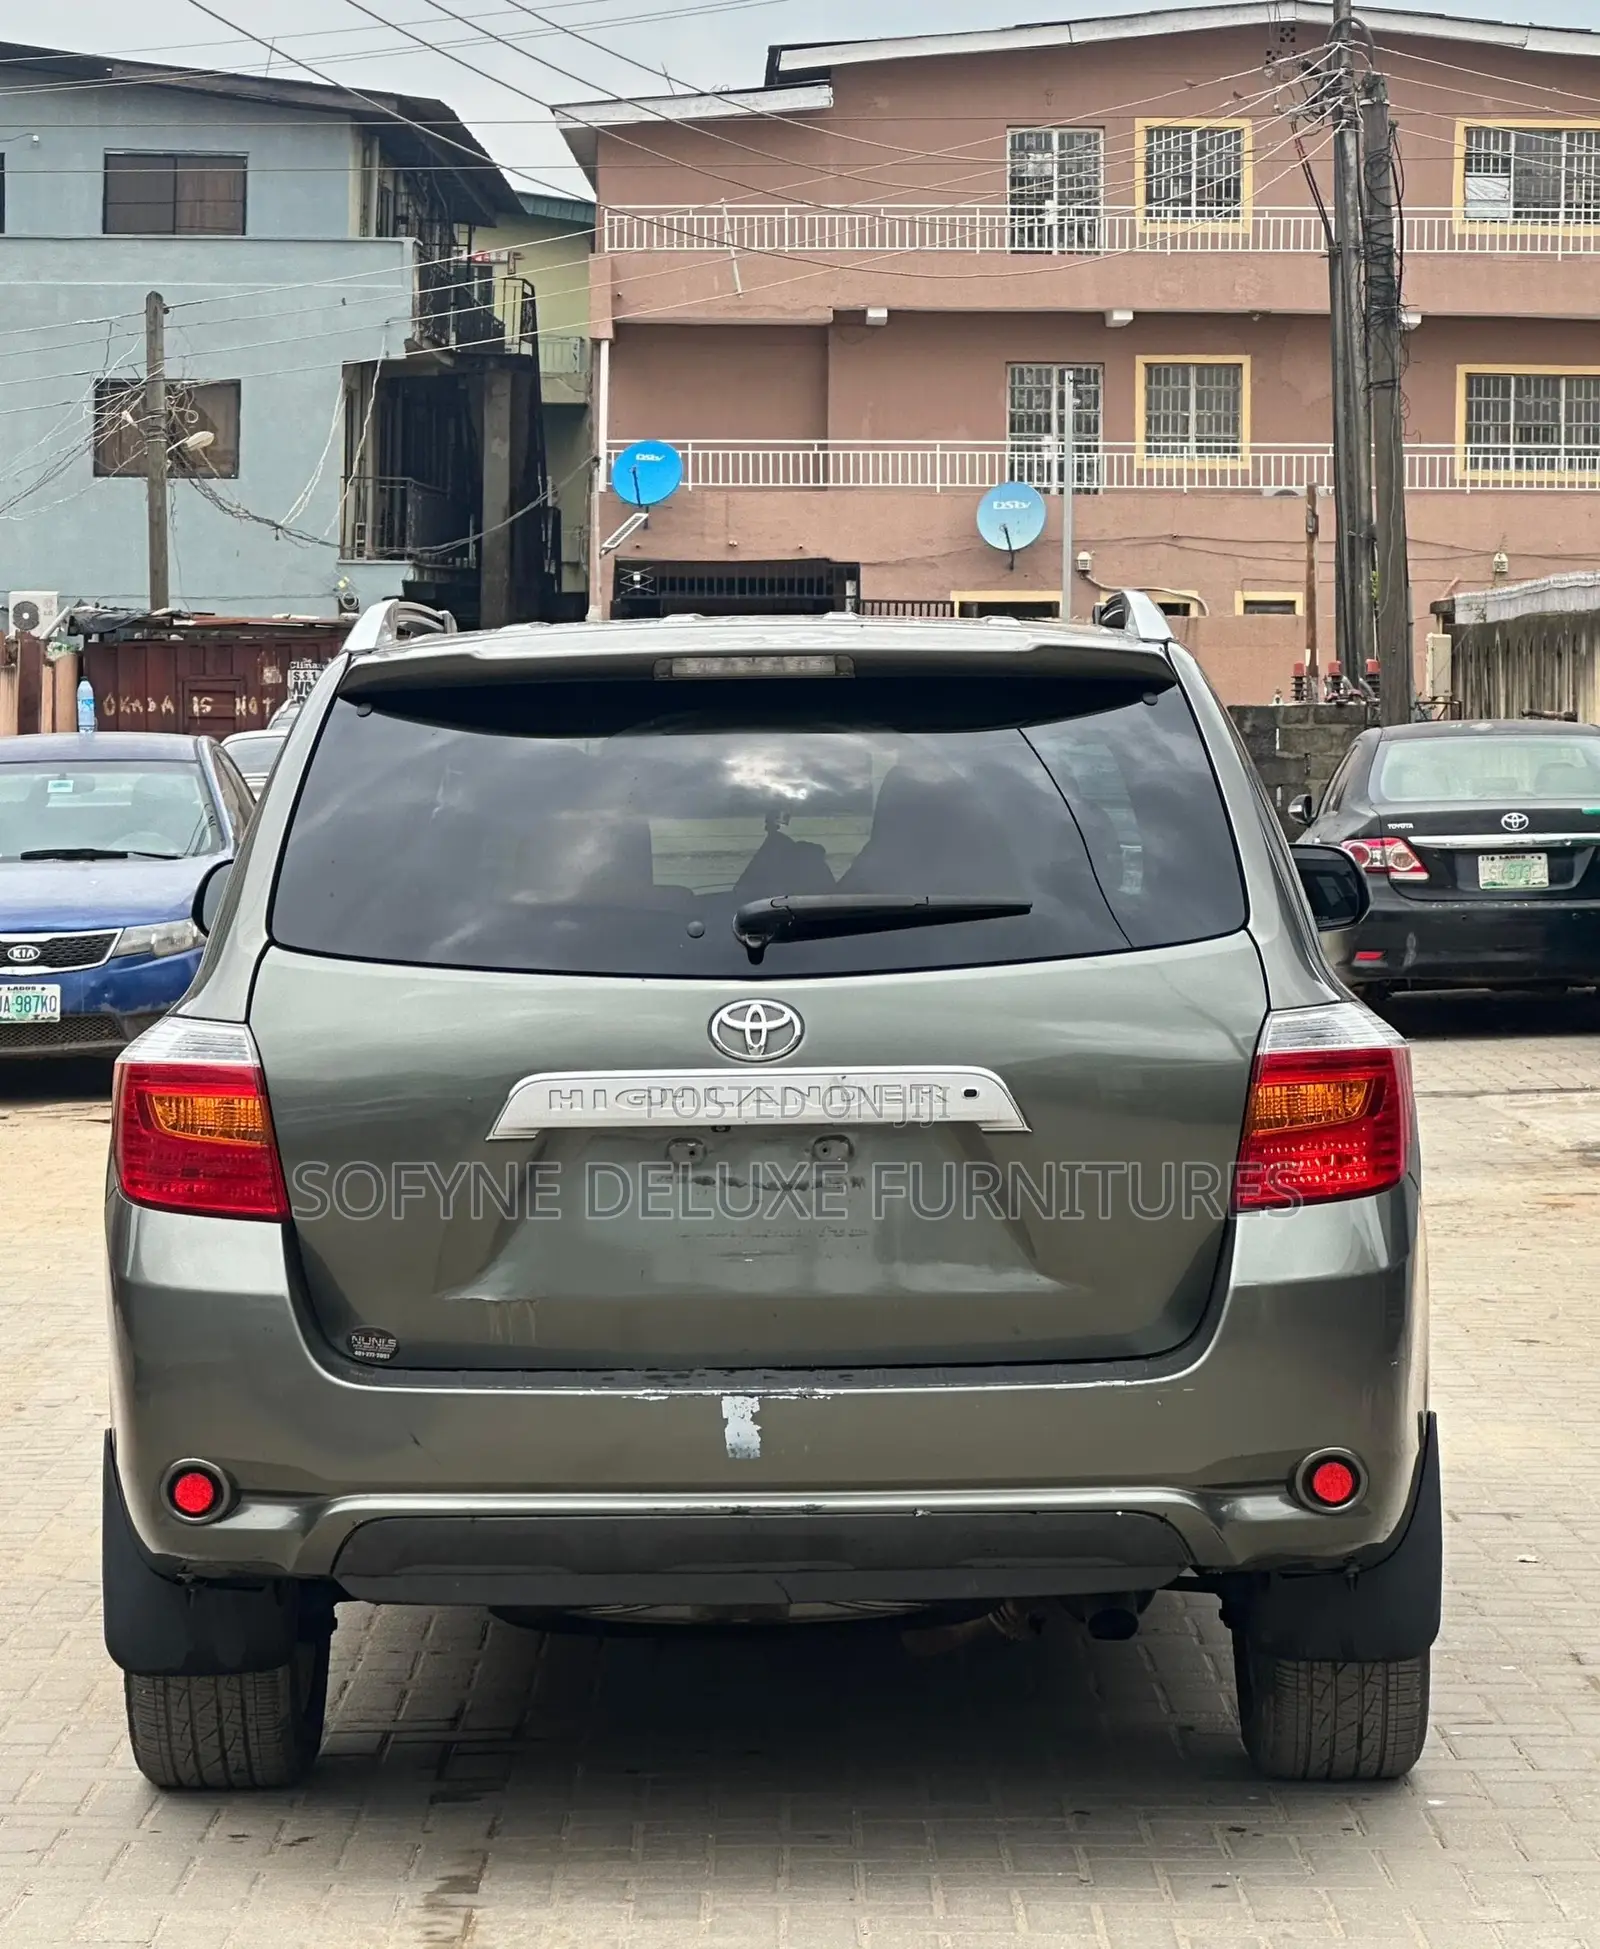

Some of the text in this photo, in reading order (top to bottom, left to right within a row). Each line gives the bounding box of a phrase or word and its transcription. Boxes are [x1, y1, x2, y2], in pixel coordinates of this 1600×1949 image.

[102, 692, 275, 718] OKADA IS NOT
[1387, 822, 1414, 830] TOYOTA
[12, 948, 35, 959] KIA
[547, 1084, 950, 1111] HIGHLANDER
